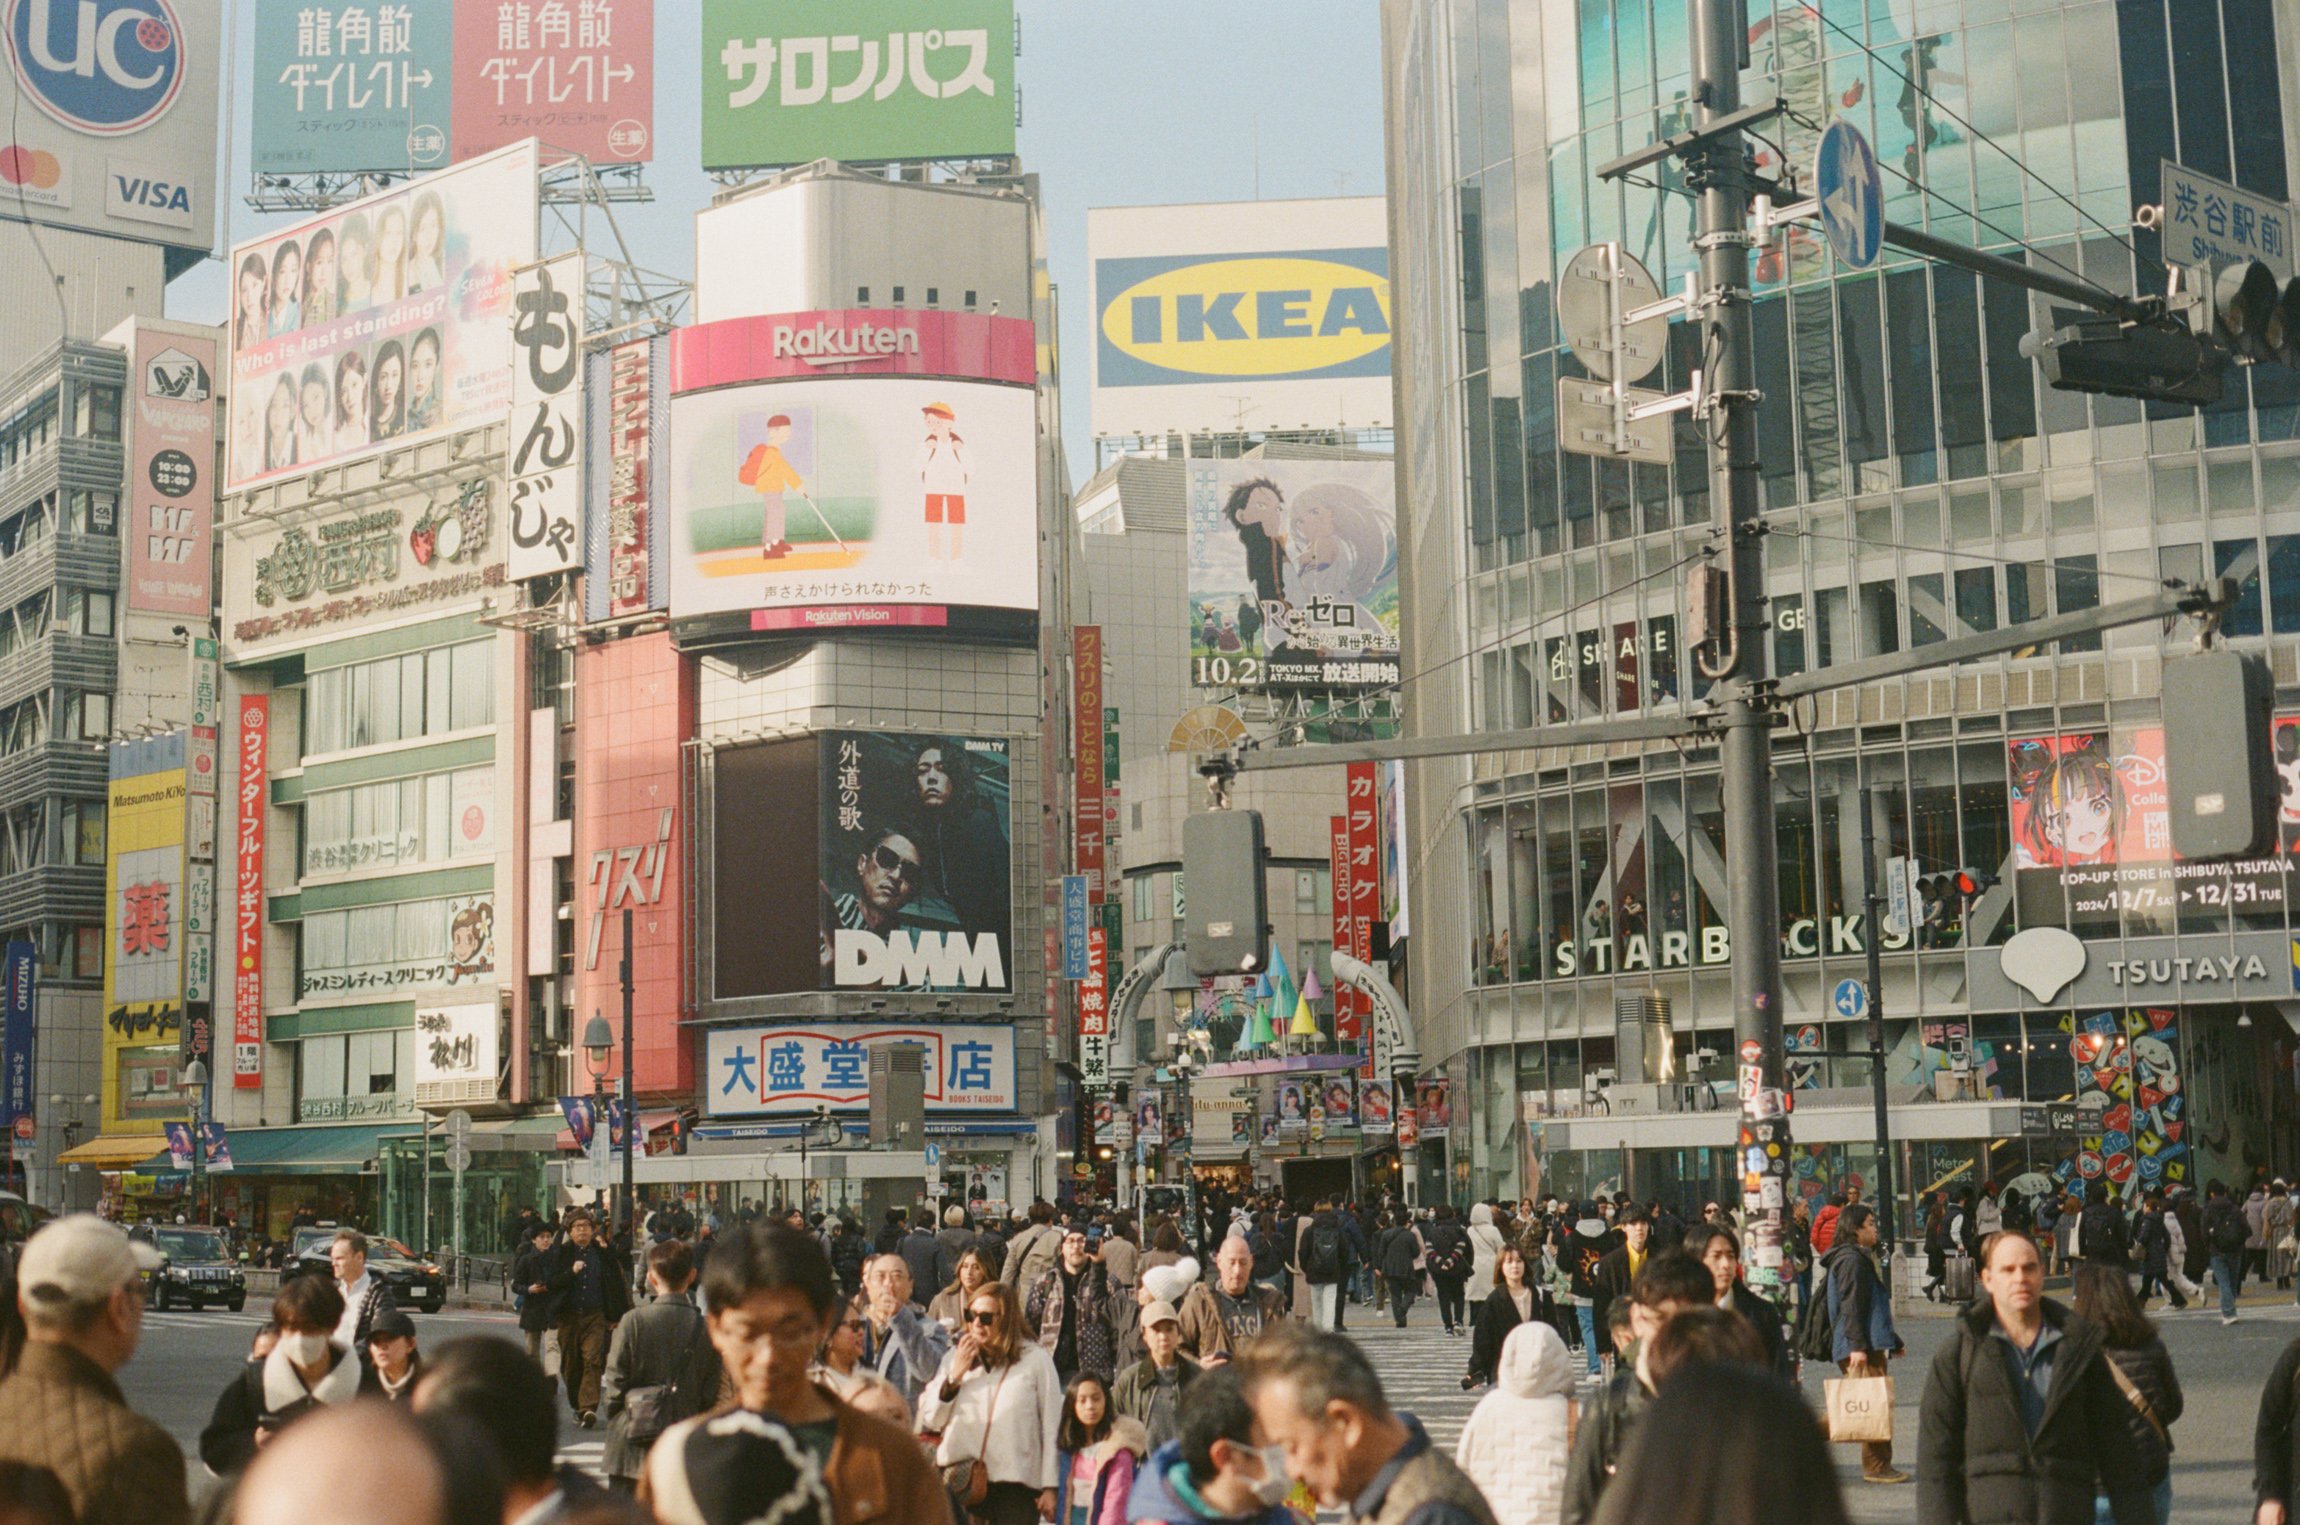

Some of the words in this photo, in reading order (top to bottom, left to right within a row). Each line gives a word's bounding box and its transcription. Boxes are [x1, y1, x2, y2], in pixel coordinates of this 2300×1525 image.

[298, 4, 413, 57] 龍角散
[498, 0, 613, 50] 龍角散
[278, 61, 434, 112] ダイレクト
[479, 55, 635, 105] ダイレクト
[721, 29, 995, 109] サロンパス
[112, 175, 190, 213] VISA
[2174, 180, 2283, 258] 渋谷駅前
[1131, 287, 1391, 344] IKEA
[235, 350, 274, 376] Who
[279, 344, 296, 360] is
[302, 330, 337, 353] last
[343, 295, 446, 341] standing?
[773, 322, 919, 358] Rakuten
[509, 267, 577, 563] もんじゃ
[150, 506, 194, 533] B1F
[149, 535, 196, 565] B2F
[764, 581, 933, 600] 声さえかけられなかった
[805, 610, 852, 624] Rakuten
[854, 608, 890, 622] Vision
[1197, 657, 1257, 684] 10.2
[1270, 664, 1302, 674] TOKYO
[1322, 661, 1400, 684] 放送開始
[1079, 632, 1097, 786] クスリのことなら
[113, 788, 167, 808] Matsumoto
[838, 740, 864, 832] 外道の歌
[239, 731, 262, 954] ウィンターフルーツギフト
[1334, 834, 1348, 867] BIG
[1350, 774, 1377, 901] カラオケ
[585, 806, 676, 970] クスリ
[1335, 867, 1348, 902] ECHO
[2060, 870, 2111, 886] POP-UP
[2113, 868, 2156, 882] STORE
[2159, 866, 2172, 879] in
[2175, 862, 2234, 878] SHIBUYA
[2235, 859, 2295, 875] TSUTAYA
[2196, 881, 2257, 907] 12/31
[2260, 889, 2282, 901] TUE
[123, 881, 170, 955] 薬
[834, 929, 1006, 988] DMM
[1556, 912, 1909, 978] STARBCKS
[17, 956, 30, 1012] MIZUHO
[303, 965, 446, 993] ジャスミンレディースクリニック
[2107, 954, 2267, 984] TSUTAYA
[722, 1040, 993, 1097] 大盛堂店
[1085, 1036, 1104, 1077] 牛繁
[13, 1052, 25, 1111] みずほ銀行
[949, 1095, 971, 1104] BOOKS
[973, 1095, 1005, 1104] TAISEIDO
[732, 1128, 769, 1137] TAISEIDO
[923, 1125, 966, 1134] AISEIDO
[1933, 1169, 1973, 1183] Qest
[1845, 1400, 1870, 1414] GU
